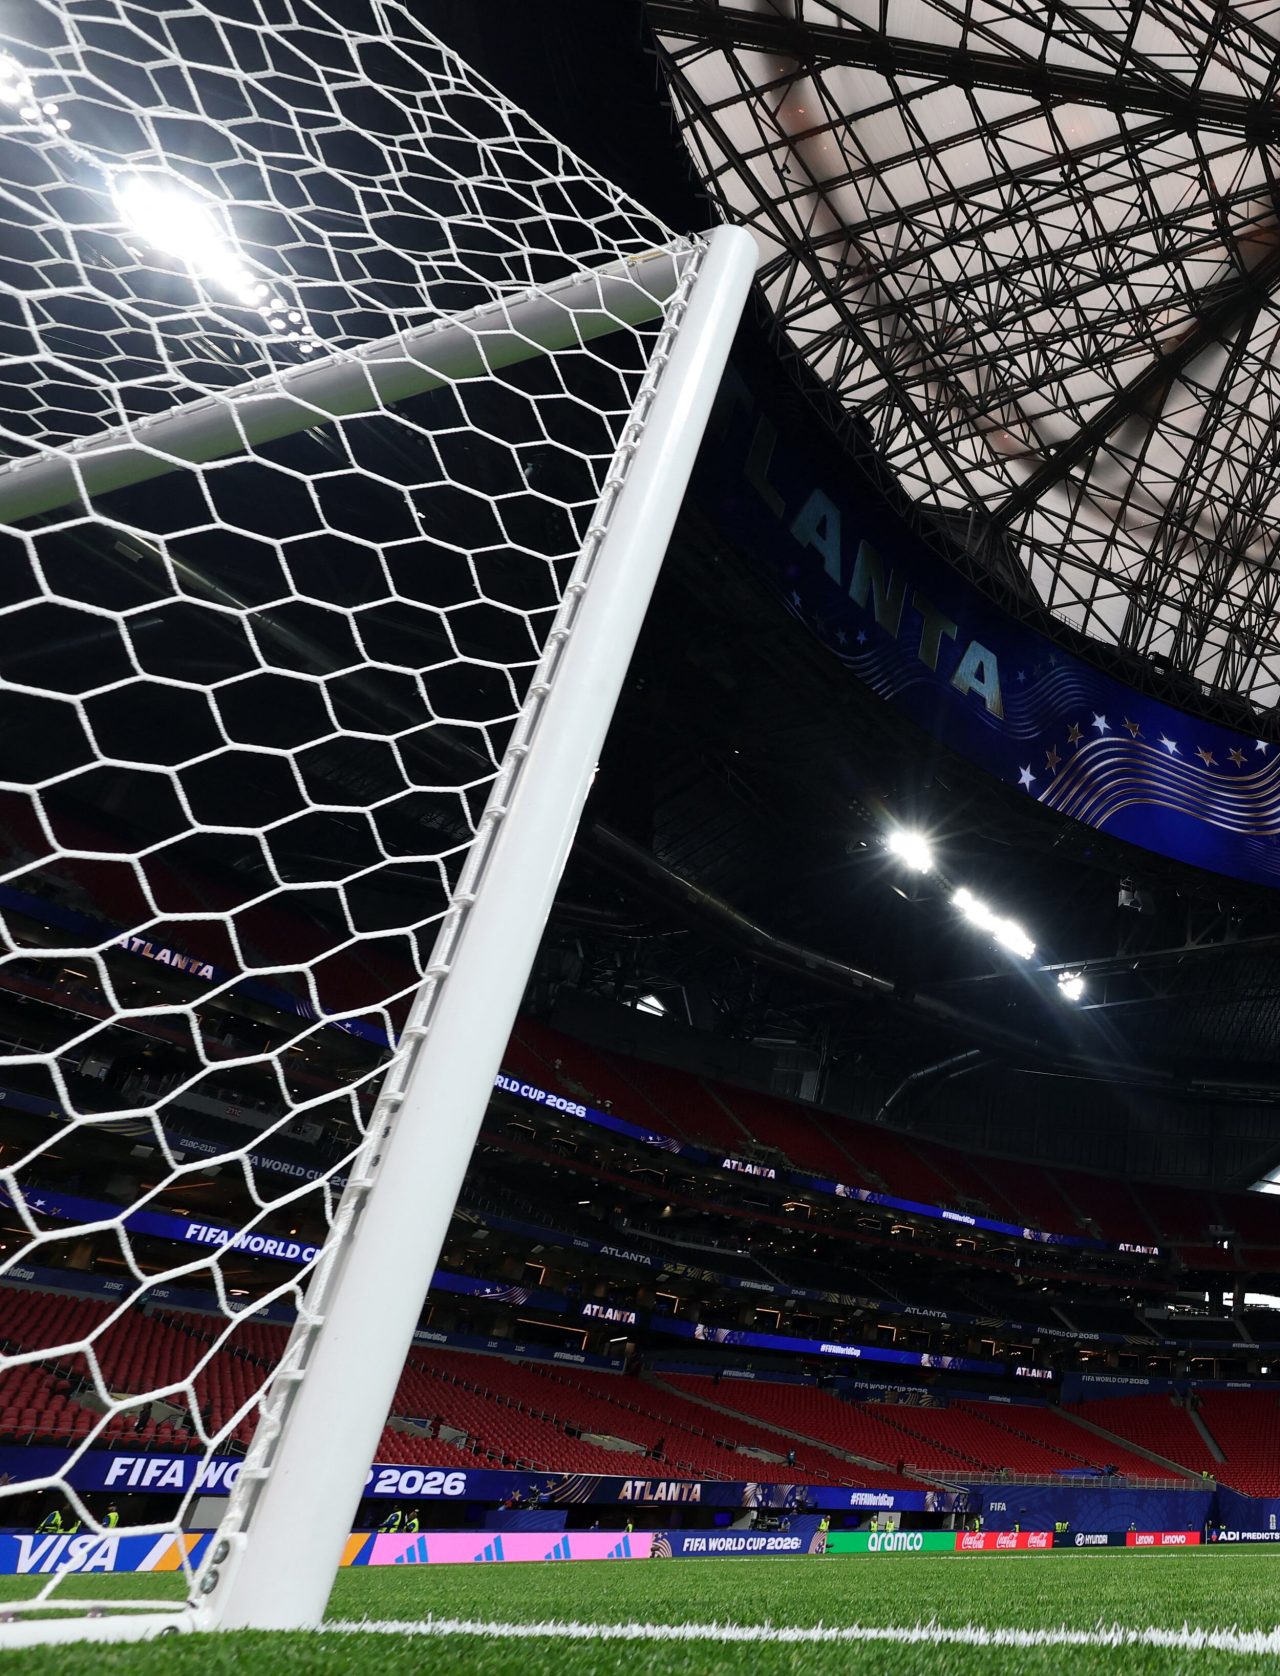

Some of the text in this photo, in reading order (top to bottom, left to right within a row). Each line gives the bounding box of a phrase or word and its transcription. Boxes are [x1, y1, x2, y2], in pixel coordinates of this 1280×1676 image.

[495, 1075, 587, 1118] RLD CUP 2026
[261, 1158, 305, 1177] WORLD
[722, 1157, 777, 1180] ATLANTA
[185, 1223, 229, 1246] FIFA
[600, 1245, 651, 1266] ATLANTA
[1118, 1242, 1159, 1256] ATLANTA
[582, 1303, 636, 1325] ATLANTA
[904, 1306, 947, 1319] ATLANTA
[1016, 1366, 1053, 1380] ATLANTA
[104, 1457, 184, 1488] FIFA
[374, 1469, 464, 1495] 2026
[618, 1480, 701, 1502] ATLANTA
[990, 1502, 1006, 1512] FIFA
[683, 1537, 800, 1551] FIFA WORLD CUP 2026
[867, 1532, 923, 1551] aramco
[1085, 1534, 1108, 1544] HYUNDAI
[1135, 1534, 1186, 1544] Lenovo Lenovo
[1218, 1531, 1240, 1541] ADI
[12, 1535, 121, 1573] VISA
